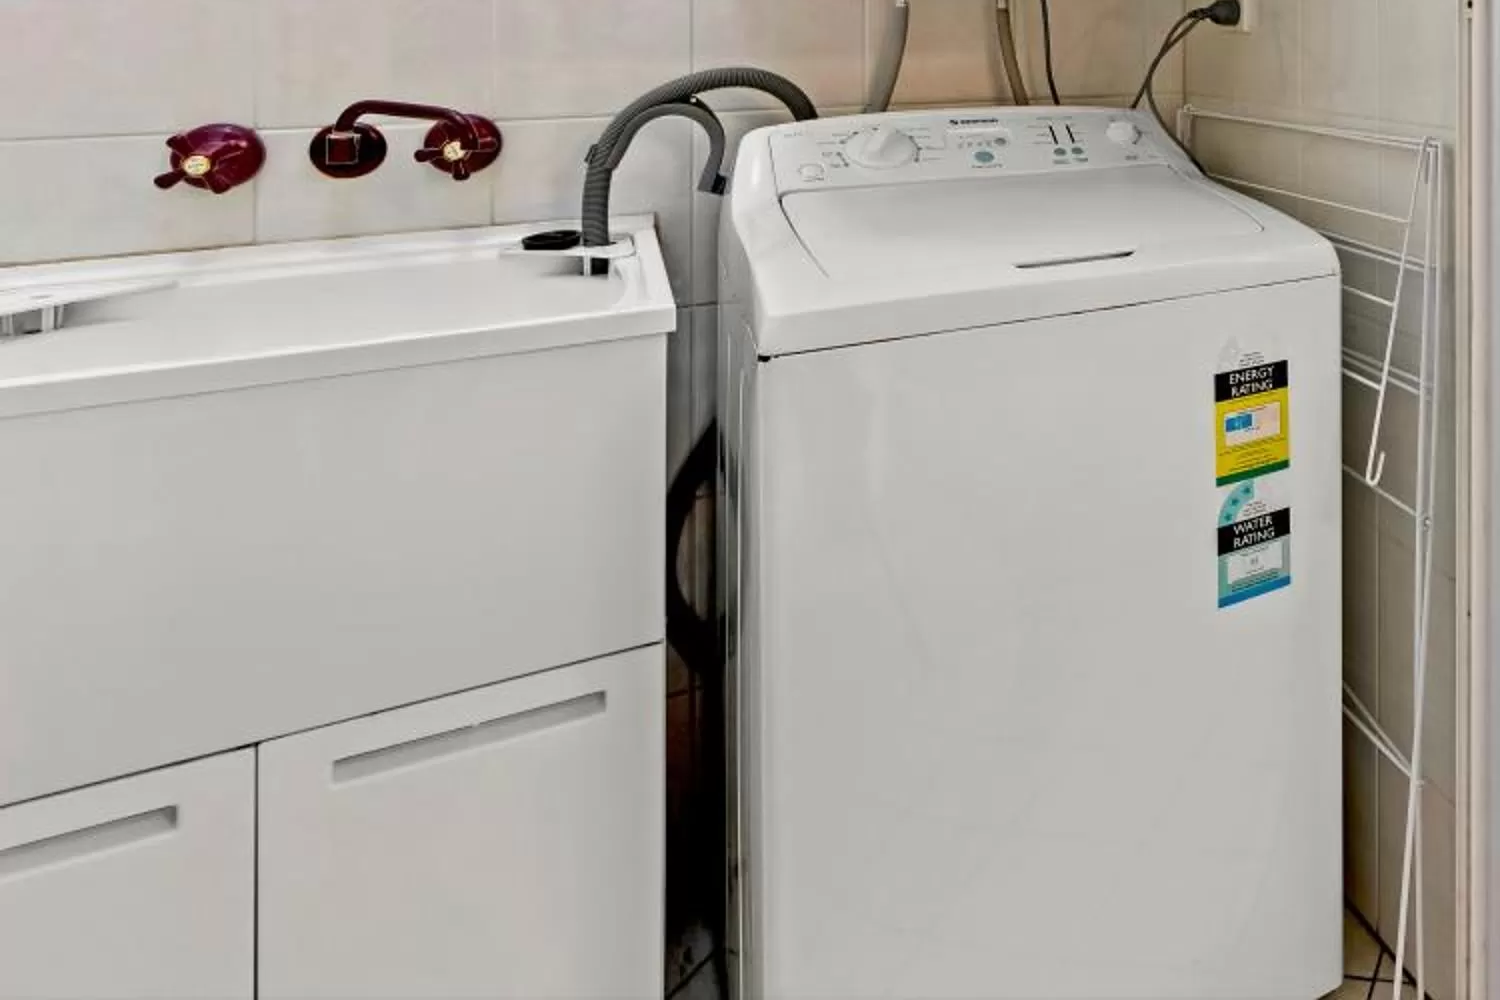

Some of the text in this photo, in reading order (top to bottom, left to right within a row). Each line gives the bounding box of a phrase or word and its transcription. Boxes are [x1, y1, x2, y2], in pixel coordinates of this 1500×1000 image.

[1229, 365, 1274, 385] ENERGY
[1231, 379, 1273, 398] RATING
[1233, 516, 1273, 535] WATER
[1233, 527, 1275, 548] RATING
